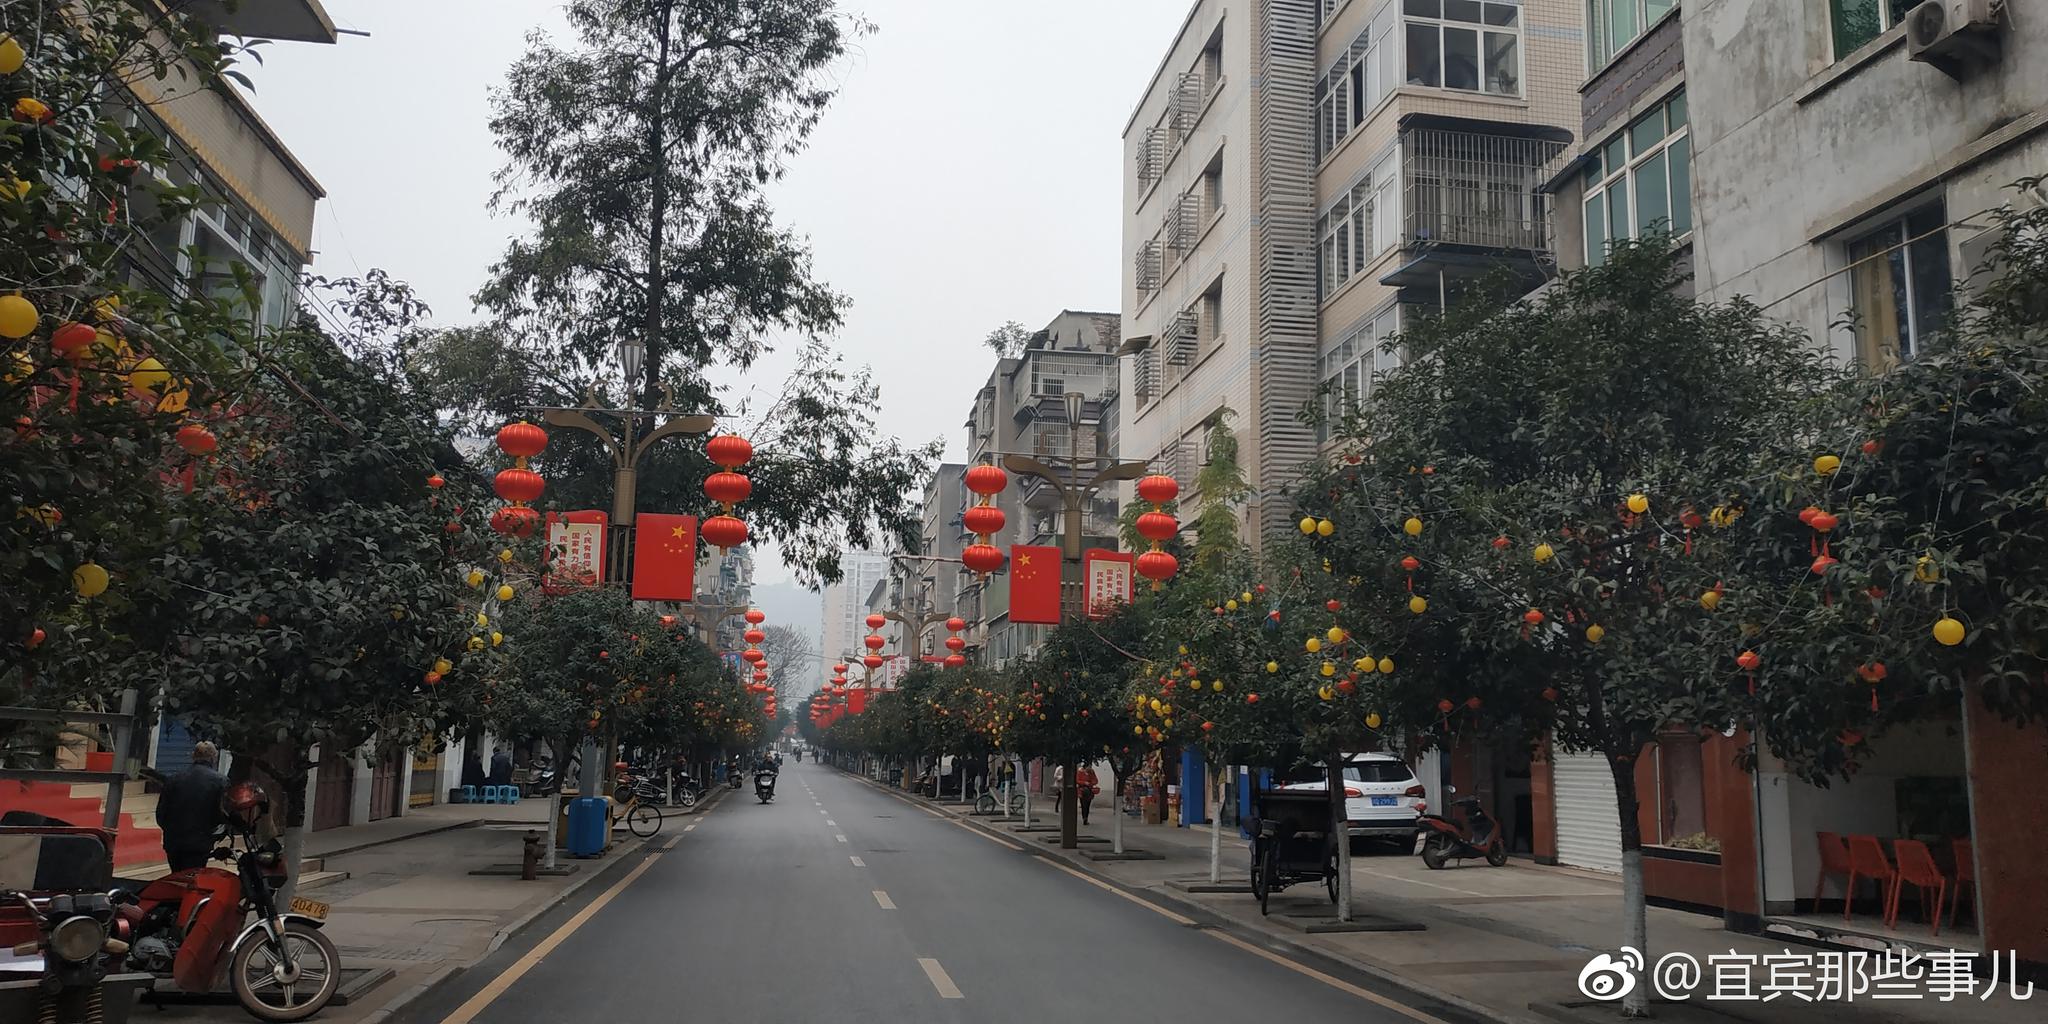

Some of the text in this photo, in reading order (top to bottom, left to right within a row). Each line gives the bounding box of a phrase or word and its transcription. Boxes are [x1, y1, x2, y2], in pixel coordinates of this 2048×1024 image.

[583, 529, 592, 567] 人民有信仰
